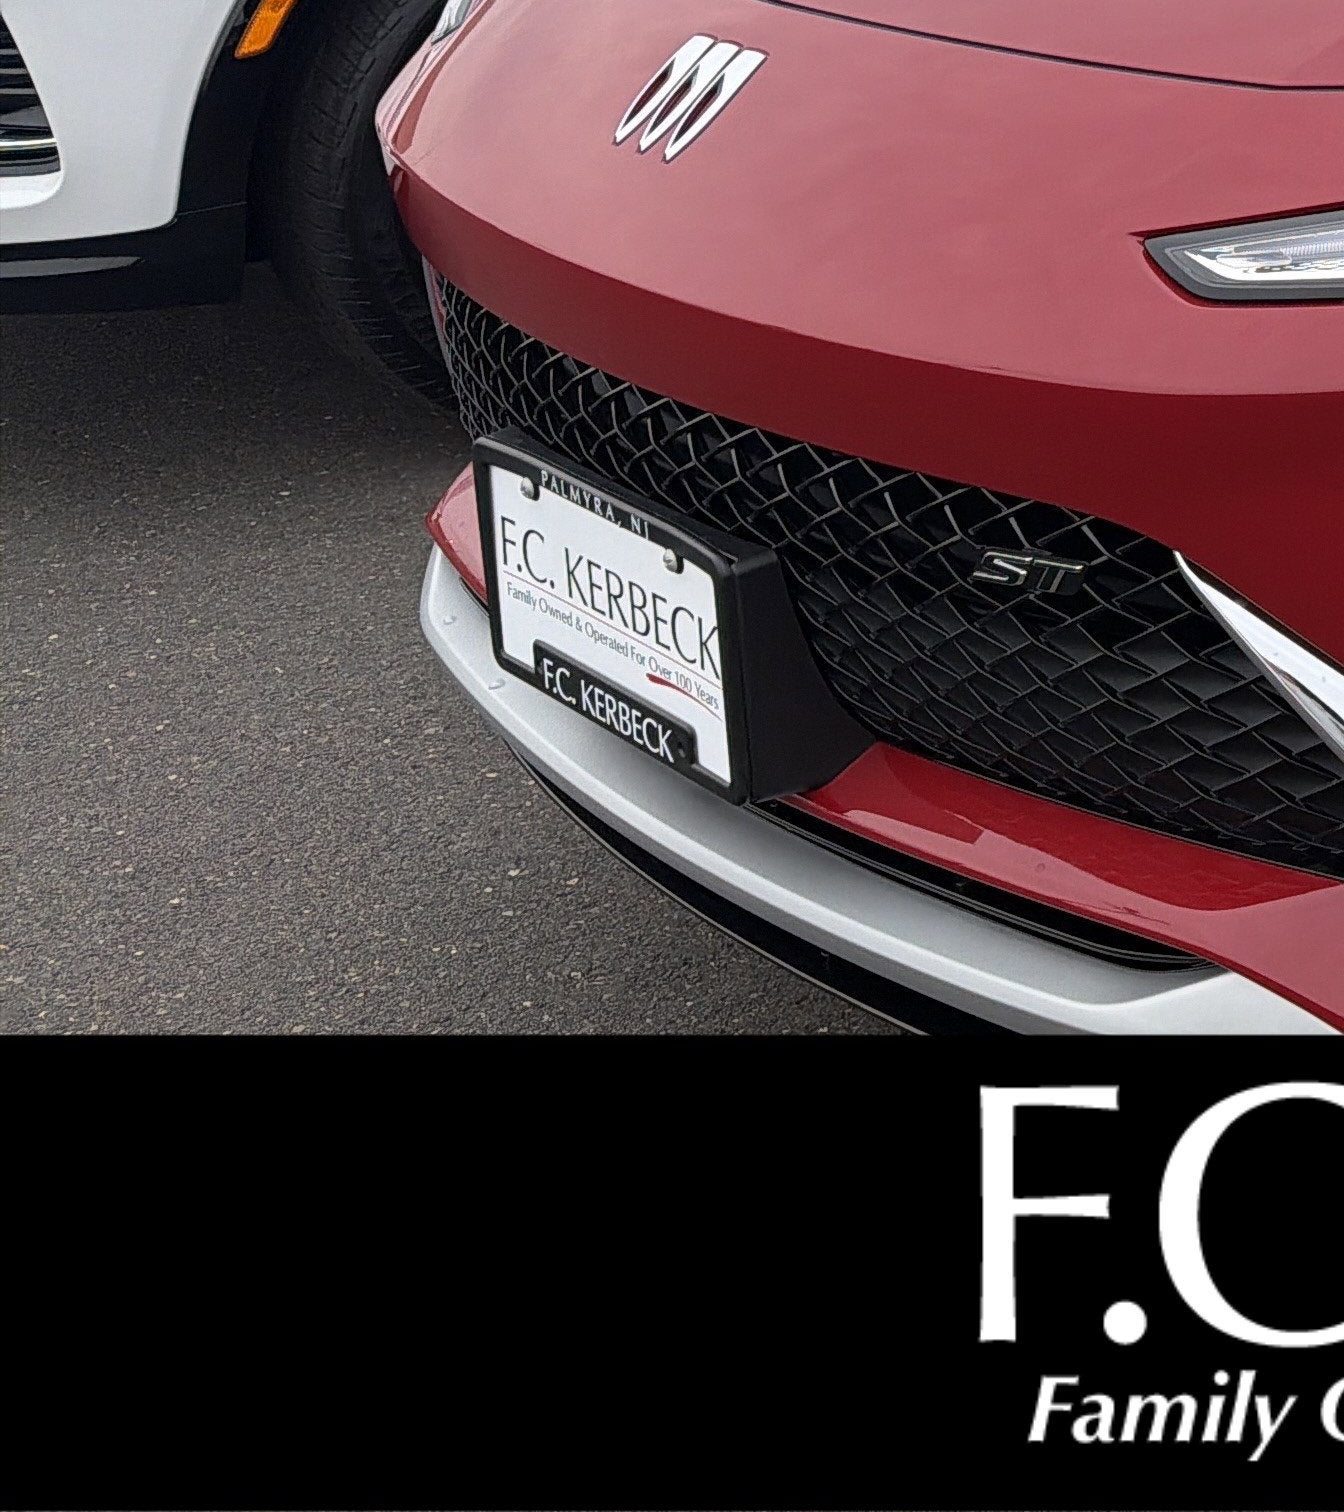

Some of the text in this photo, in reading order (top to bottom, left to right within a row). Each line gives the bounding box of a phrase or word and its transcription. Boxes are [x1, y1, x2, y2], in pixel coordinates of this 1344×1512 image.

[541, 470, 649, 539] PALMYRA, NJ
[501, 515, 720, 680] F.C. KERBECK
[973, 551, 1085, 593] ST
[507, 582, 537, 611] Family
[539, 598, 573, 625] Owned
[575, 617, 583, 632] &
[585, 622, 629, 660] Operated
[630, 644, 646, 667] For
[649, 656, 673, 680] Over
[675, 671, 692, 693] 100
[543, 658, 674, 763] F.C. KERBECK
